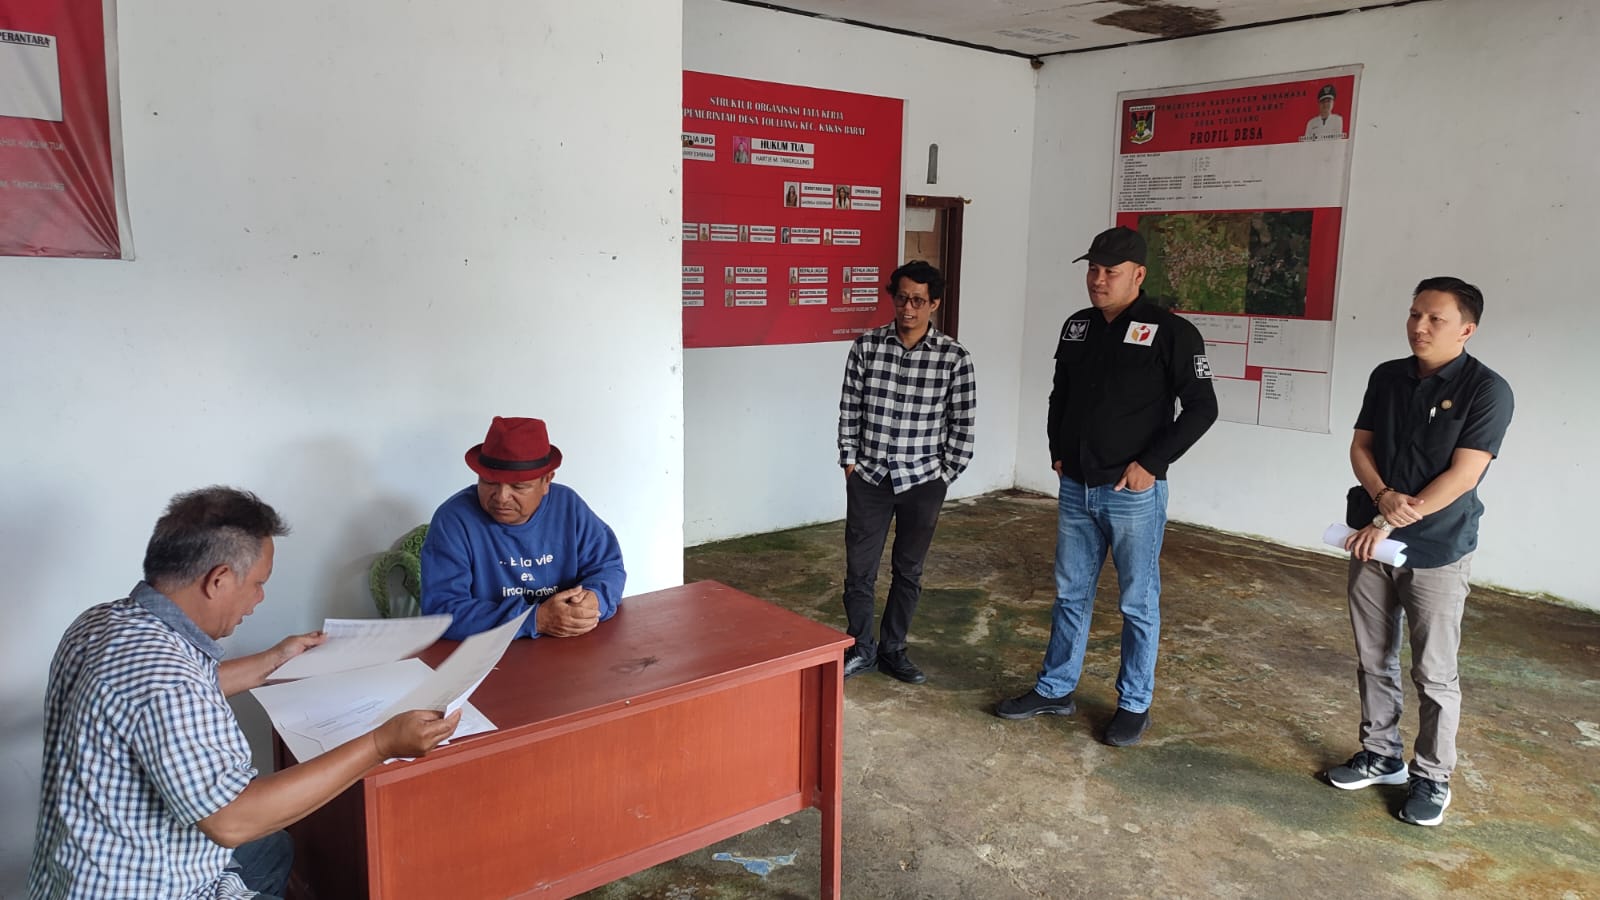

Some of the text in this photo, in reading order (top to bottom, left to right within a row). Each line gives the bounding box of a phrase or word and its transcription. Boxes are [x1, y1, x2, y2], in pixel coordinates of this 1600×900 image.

[0, 31, 50, 46] ERANTARA
[709, 96, 844, 120] STRUKTUR ORGANISASI TATA KERJA
[683, 108, 736, 123] PEMERINTAH
[738, 114, 759, 125] DESA
[819, 123, 842, 133] KAKAS
[844, 126, 865, 136] BARAT
[700, 136, 714, 144] BPD
[1190, 127, 1263, 144] PROFIL DESA
[760, 139, 805, 152] HUKUM TUA
[520, 557, 532, 567] la
[535, 554, 553, 566] vie
